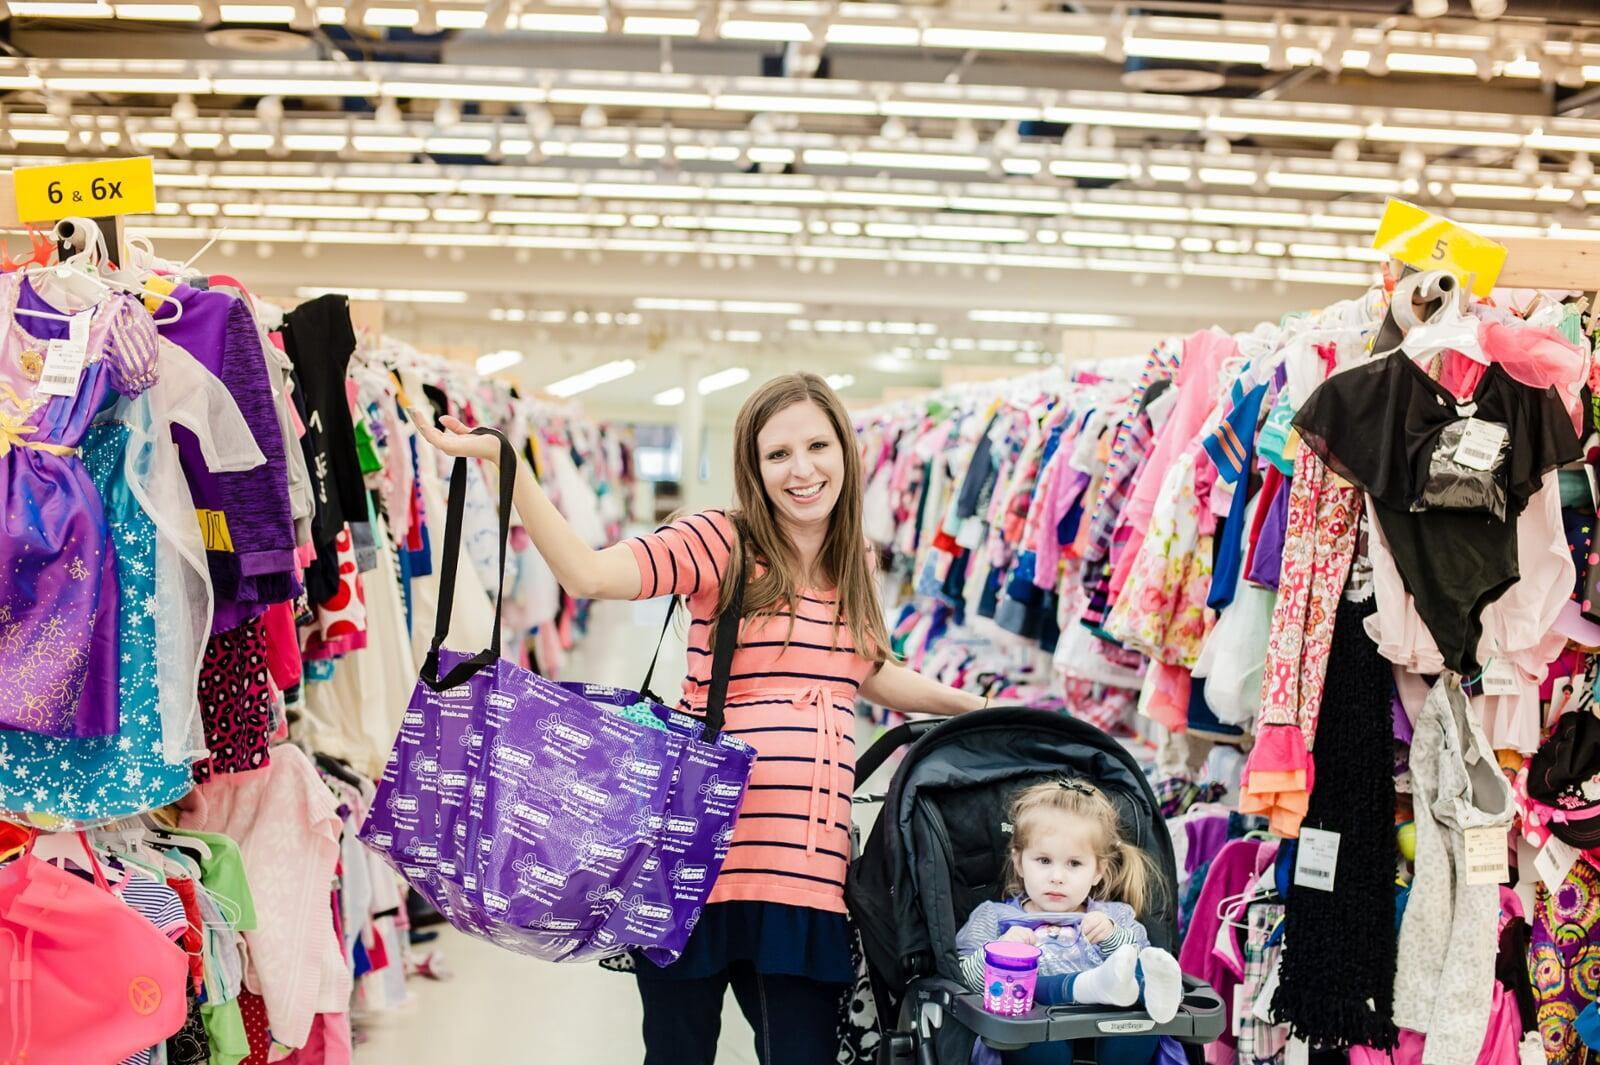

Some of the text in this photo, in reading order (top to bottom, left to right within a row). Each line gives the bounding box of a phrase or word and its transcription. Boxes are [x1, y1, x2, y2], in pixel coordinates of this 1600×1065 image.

[47, 177, 123, 204] 6 & 6x
[1431, 239, 1448, 260] 5
